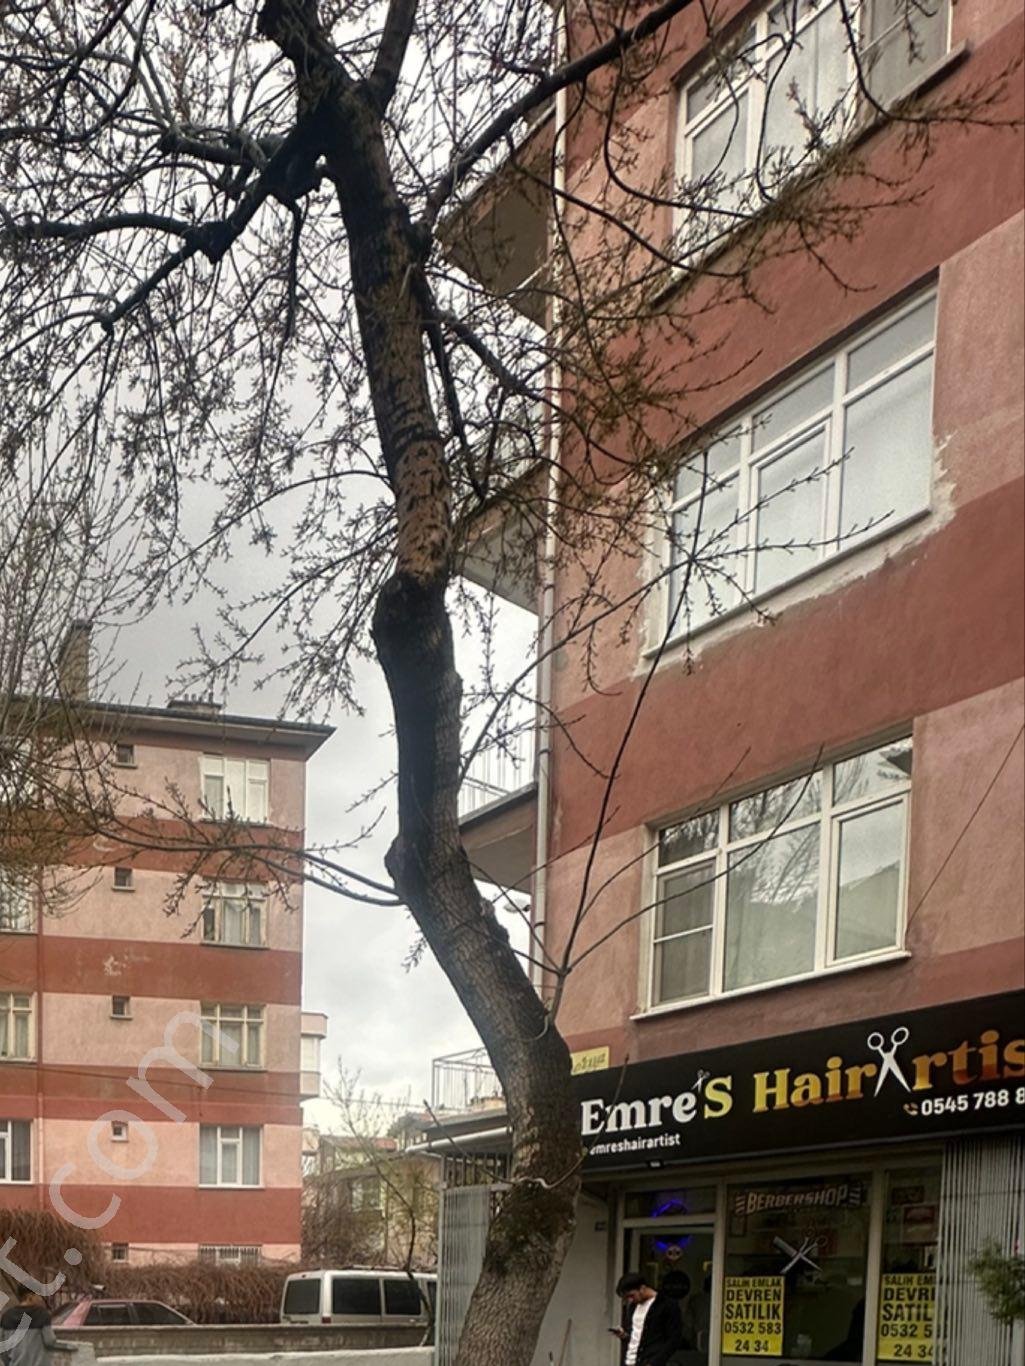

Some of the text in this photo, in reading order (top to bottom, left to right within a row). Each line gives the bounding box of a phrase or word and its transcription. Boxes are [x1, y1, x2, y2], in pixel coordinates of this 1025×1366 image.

[921, 1094, 969, 1116] 0545
[973, 1090, 1009, 1110] 788
[726, 1288, 782, 1302] DEVREN
[725, 1303, 781, 1320] SATILIK
[725, 1321, 782, 1335] 0532 583
[881, 1323, 918, 1337] 0532
[735, 1338, 750, 1351] 24
[893, 1343, 913, 1358] 24
